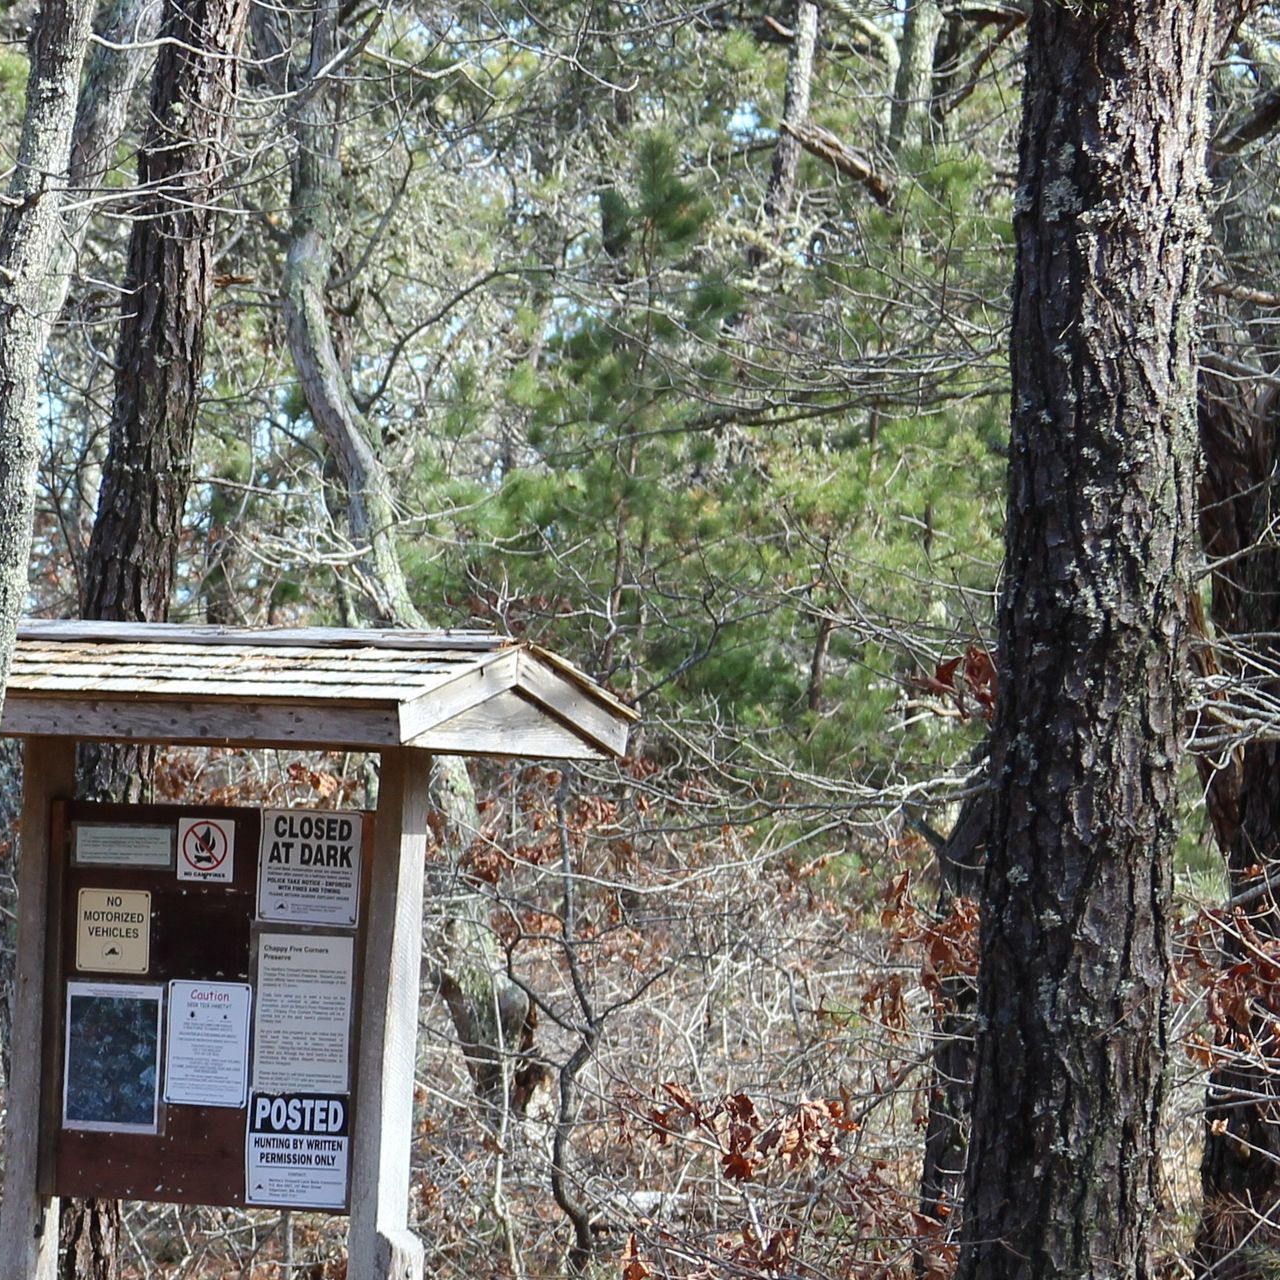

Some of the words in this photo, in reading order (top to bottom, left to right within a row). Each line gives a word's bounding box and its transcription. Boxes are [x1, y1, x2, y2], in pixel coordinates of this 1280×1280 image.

[274, 815, 353, 842] CLOSED
[268, 841, 295, 865] AT
[299, 843, 354, 868] DARK
[106, 896, 122, 907] NO
[83, 910, 144, 923] MOTORIZED
[88, 926, 139, 939] VEHICLES
[263, 944, 289, 954] Chappy
[289, 945, 302, 953] Five
[304, 946, 329, 954] Corners
[190, 989, 230, 1002] Caution
[254, 1097, 344, 1133] POSTED
[254, 1137, 290, 1150] HUNTING
[292, 1138, 304, 1150] BY
[306, 1139, 343, 1151] WRITTEN
[259, 1152, 312, 1165] PERMISSION
[314, 1154, 337, 1166] ONLY
